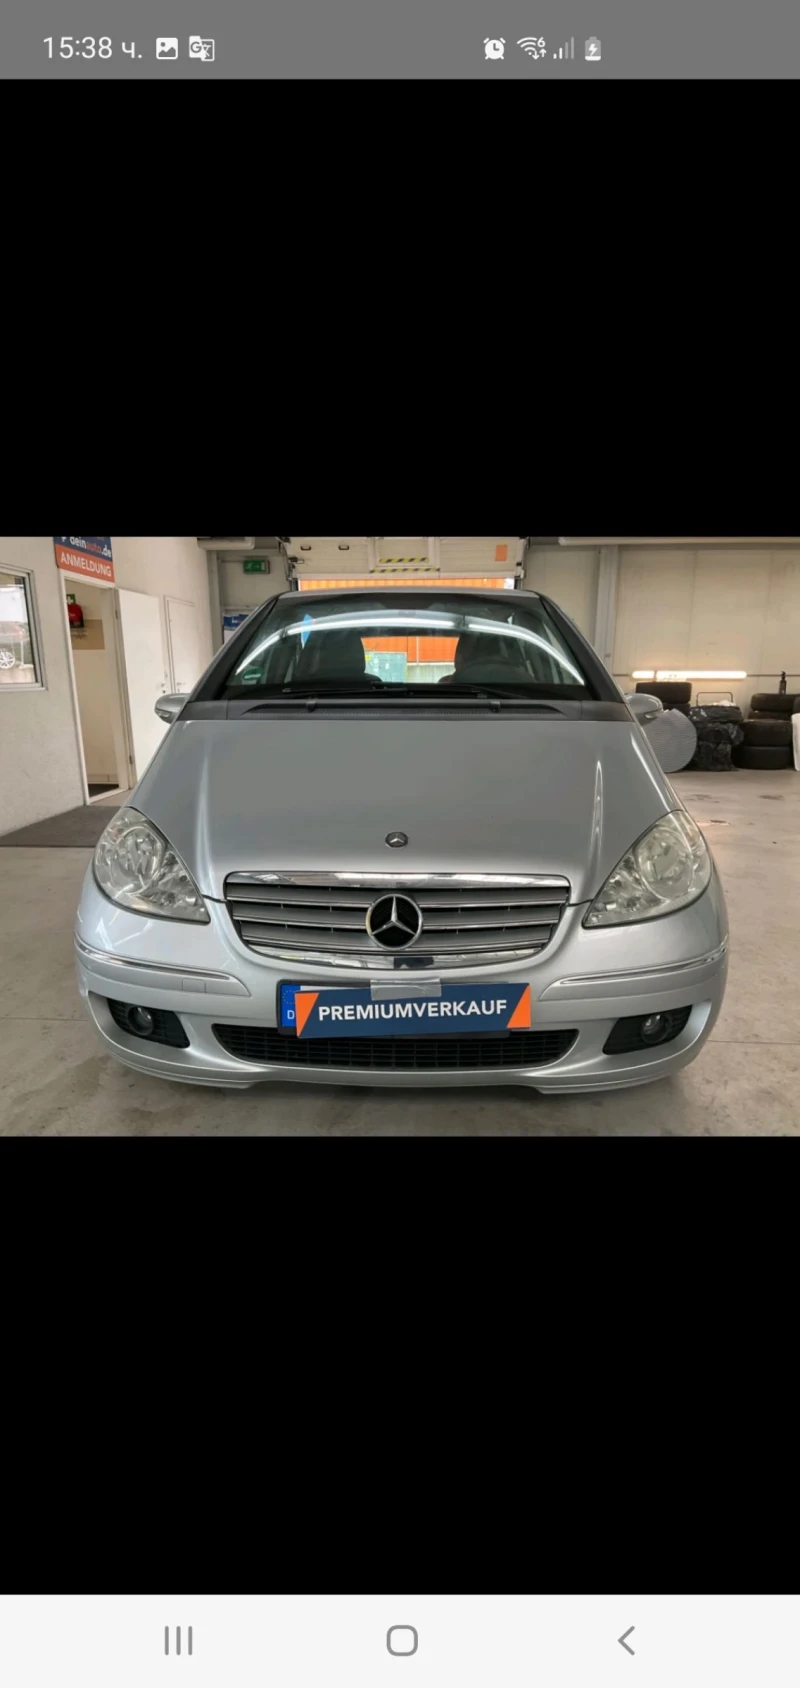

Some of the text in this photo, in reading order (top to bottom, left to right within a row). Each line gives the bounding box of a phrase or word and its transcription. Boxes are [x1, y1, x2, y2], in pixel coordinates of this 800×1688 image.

[60, 551, 112, 577] ANMELDUNG
[287, 1009, 295, 1020] D
[318, 999, 508, 1022] PREMIUMVERKAUF
